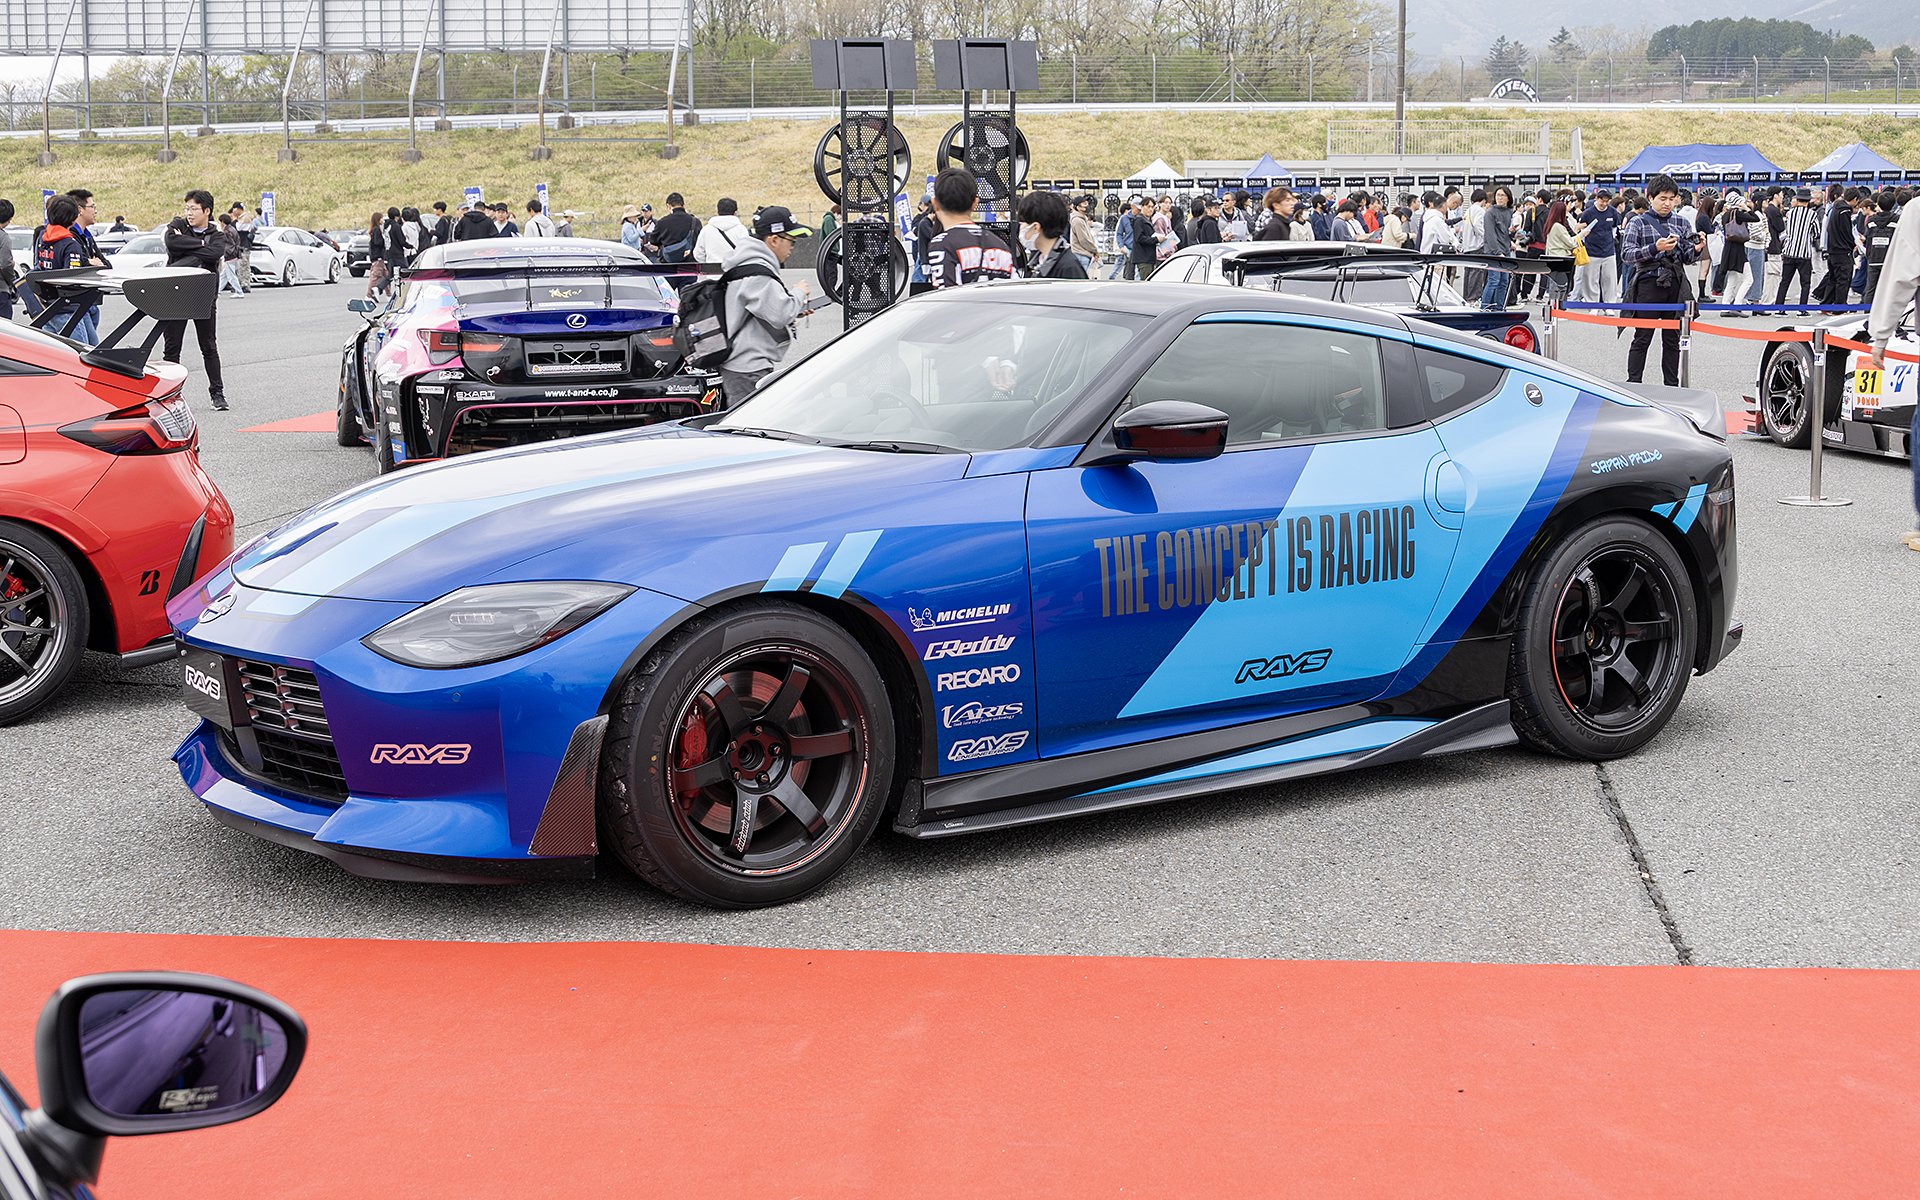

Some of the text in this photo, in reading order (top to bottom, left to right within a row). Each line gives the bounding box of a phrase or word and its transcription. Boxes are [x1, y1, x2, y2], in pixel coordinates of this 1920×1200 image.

[1659, 161, 1743, 174] RAYS
[544, 387, 619, 398] www.t-and-e.co.jp
[1859, 370, 1877, 393] 31
[456, 390, 496, 399] EXART
[1856, 396, 1880, 406] PONOS
[1590, 454, 1630, 475] JAPAN
[1093, 504, 1416, 617] THE CONCEPT IS RACING
[936, 603, 1011, 623] MICHELIN
[923, 633, 1016, 661] GReddy
[937, 663, 1021, 692] RECARO
[1234, 648, 1333, 684] RAYS
[184, 664, 221, 701] RAYS
[941, 701, 1023, 729] VARIS
[370, 743, 472, 765] RAYS
[949, 730, 1030, 760] RAYS
[853, 771, 883, 832] YOKOHAMA
